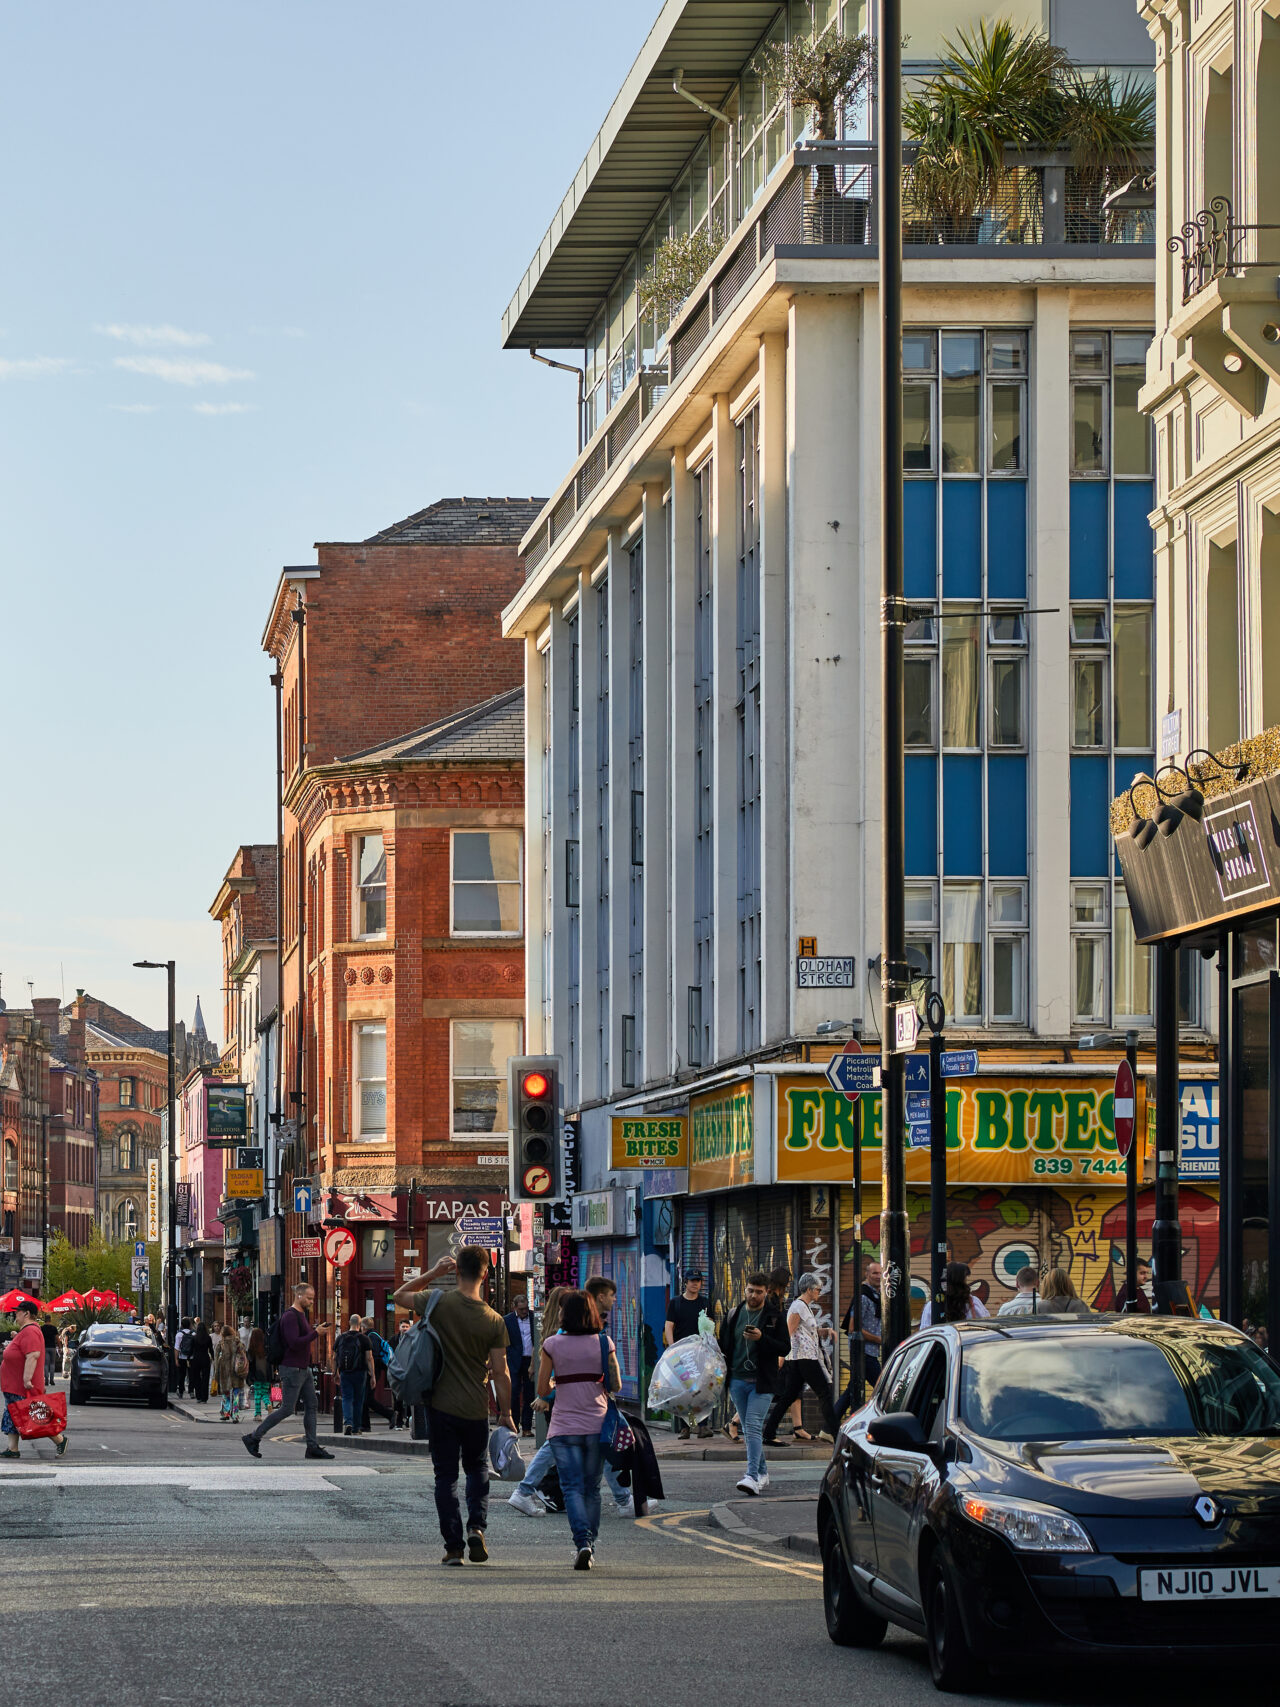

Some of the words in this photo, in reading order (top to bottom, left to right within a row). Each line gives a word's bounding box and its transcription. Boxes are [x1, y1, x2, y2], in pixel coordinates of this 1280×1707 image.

[1224, 852, 1256, 881] SOCIAL
[800, 960, 852, 972] OLDHAM
[801, 973, 851, 984] STREET
[846, 1057, 879, 1065] Piccadilly
[622, 1121, 682, 1139] FRESH
[693, 1100, 723, 1166] FRESH
[724, 1090, 753, 1159] BITES
[564, 1123, 575, 1176] ADULTS
[625, 1140, 680, 1157] BITES
[1033, 1158, 1073, 1174] 839
[1080, 1158, 1127, 1174] 7444
[178, 1184, 188, 1194] 61
[426, 1200, 490, 1219] TAPAS
[372, 1240, 389, 1258] 79
[1158, 1571, 1213, 1595] NJ10
[1222, 1569, 1269, 1594] JVL
